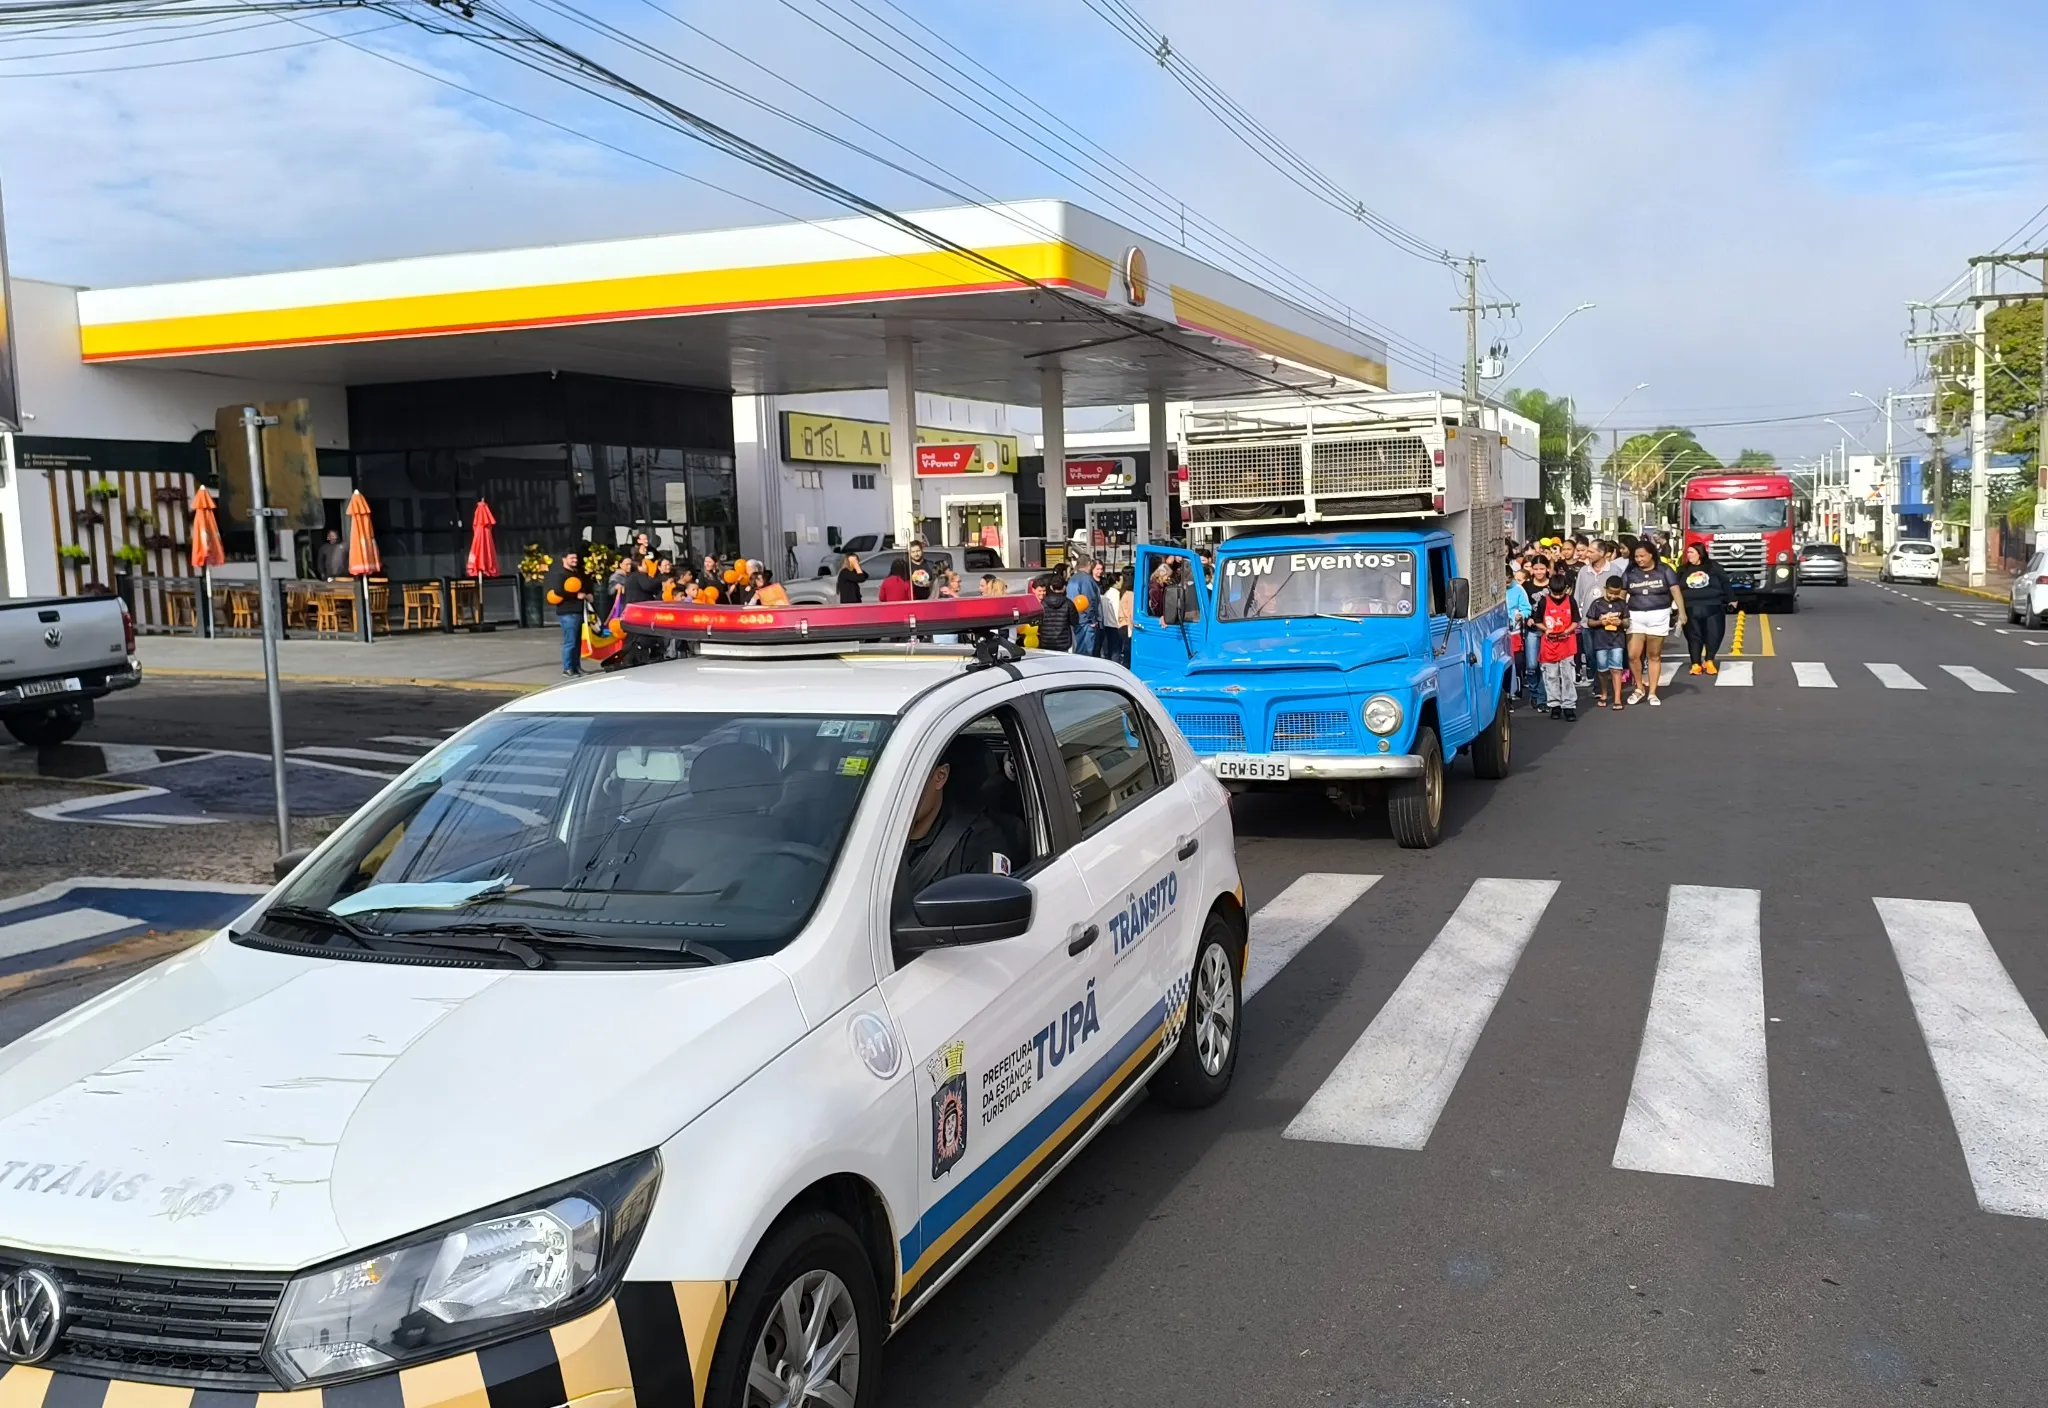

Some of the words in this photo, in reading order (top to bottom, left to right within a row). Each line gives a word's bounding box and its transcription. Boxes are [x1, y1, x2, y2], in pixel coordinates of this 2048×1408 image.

[921, 459, 958, 468] V-Power
[1290, 551, 1396, 572] Eventos
[1109, 870, 1178, 956] TRÂNSITO
[1033, 977, 1101, 1082] TUPÃ
[982, 1039, 1033, 1089] PREFEITURA
[982, 1089, 994, 1109] DA
[995, 1059, 1032, 1098] ESTÂNCIA
[981, 1086, 1021, 1127] TURÍSTICA
[1022, 1076, 1032, 1094] DE
